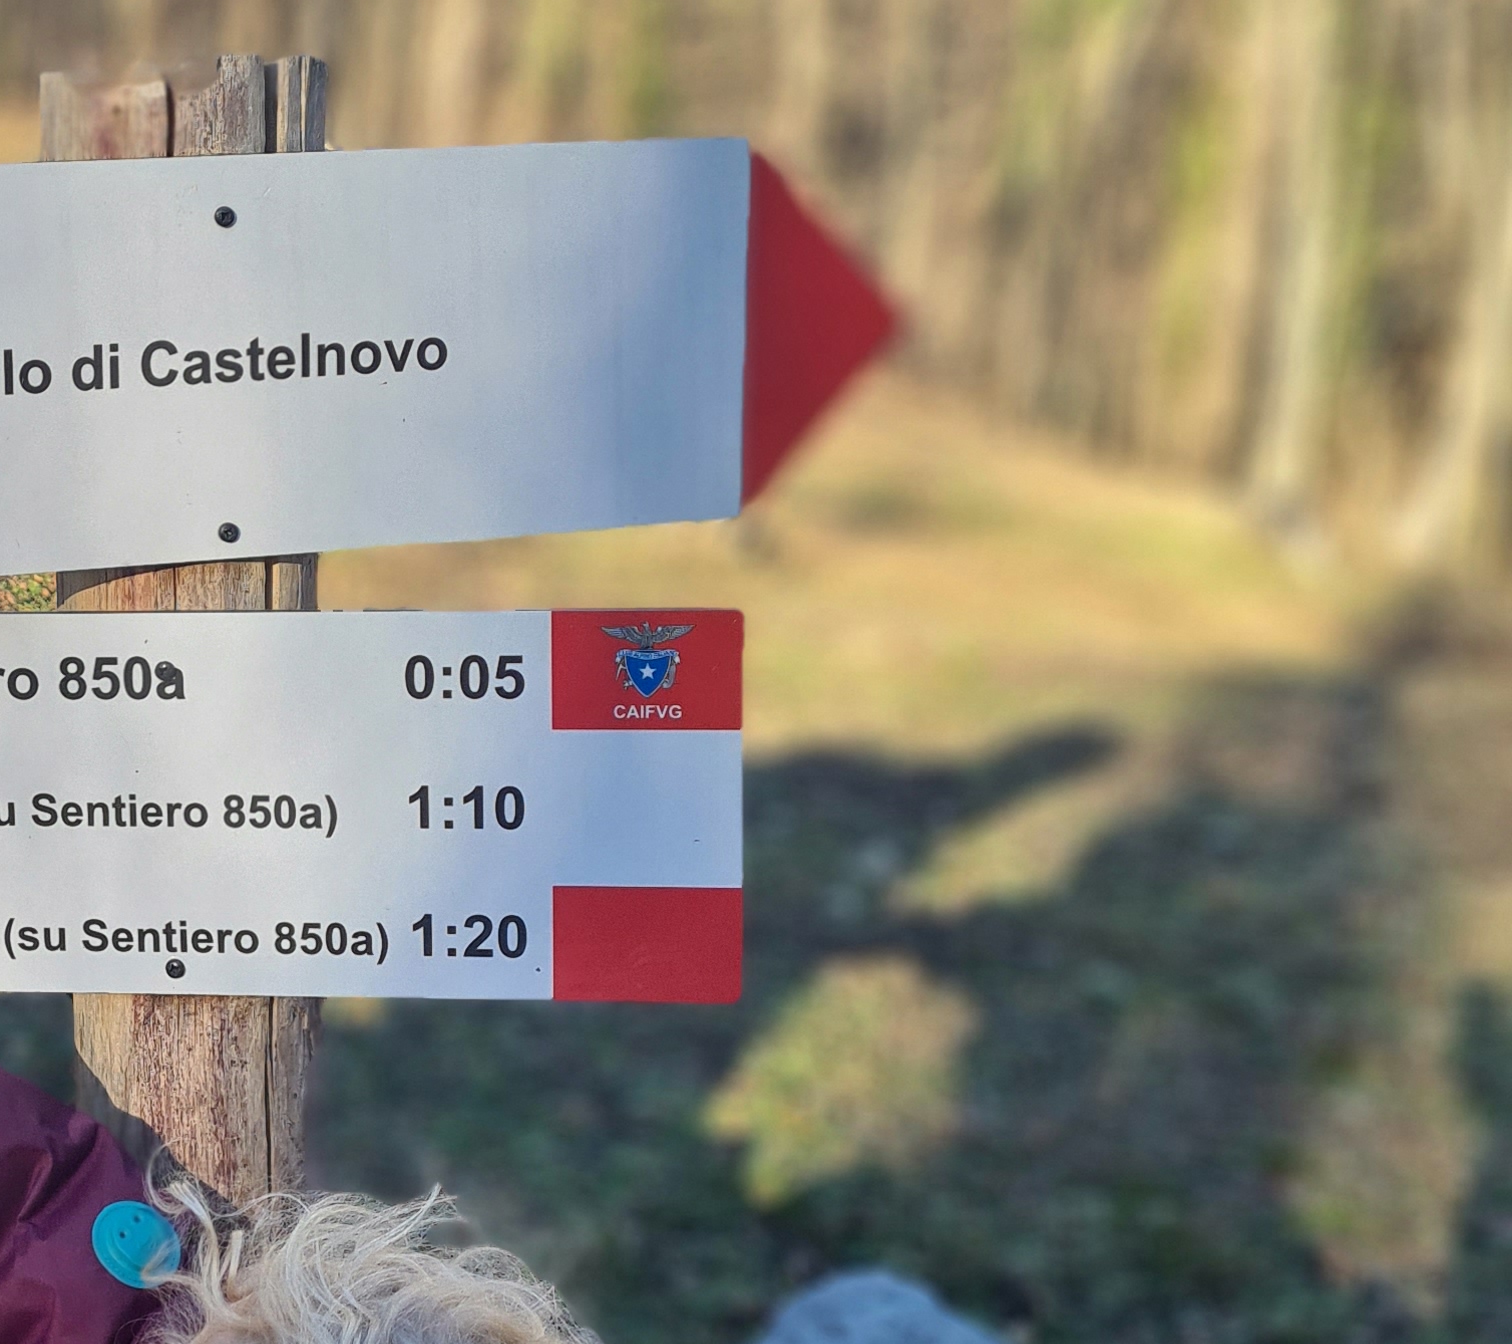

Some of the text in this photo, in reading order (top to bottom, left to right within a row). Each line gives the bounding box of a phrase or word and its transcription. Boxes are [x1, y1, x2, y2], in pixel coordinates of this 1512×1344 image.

[71, 343, 120, 391] di
[141, 332, 448, 387] Castelnovo
[59, 655, 186, 701] 850a
[403, 654, 526, 700] 0:05
[613, 704, 682, 720] CAIFVG
[31, 793, 208, 828] Sentiero
[223, 794, 338, 838] 850a)
[407, 784, 526, 831] 1:10
[3, 917, 67, 960] (su
[82, 918, 260, 955] Sentiero
[273, 922, 389, 965] 850a)
[411, 913, 528, 959] 1:20
